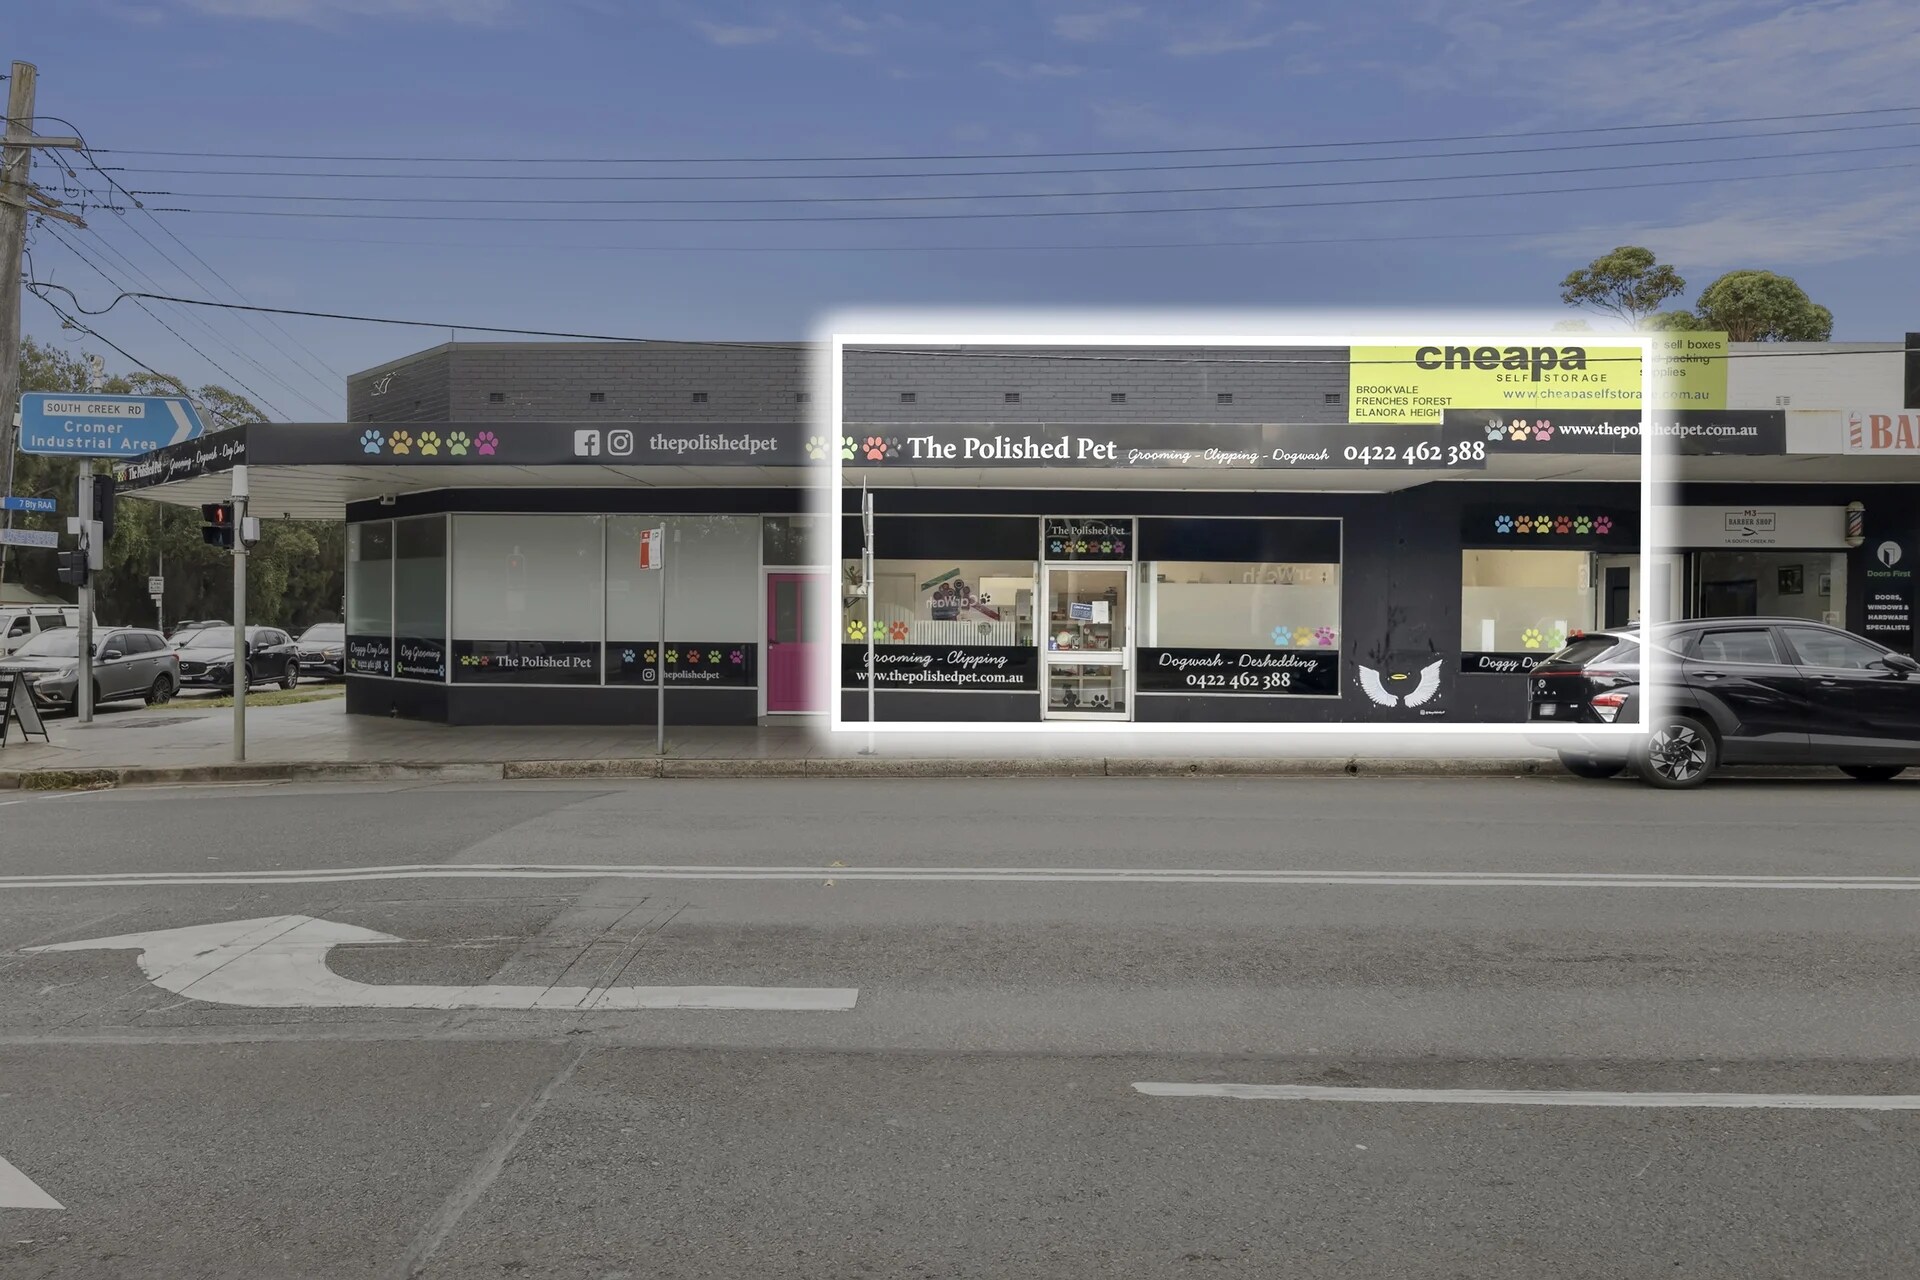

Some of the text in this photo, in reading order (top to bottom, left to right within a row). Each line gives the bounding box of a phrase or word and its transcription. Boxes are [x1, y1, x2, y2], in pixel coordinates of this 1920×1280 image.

[1664, 340, 1683, 350] sell
[1687, 339, 1721, 350] boxes
[1666, 353, 1711, 365] packing
[1496, 374, 1607, 383] SELF STORAGE
[1639, 367, 1687, 379] pplies
[1356, 385, 1419, 394] BROOKVALE
[1503, 387, 1710, 401] www.cheapaselfstorae.com.au
[1355, 396, 1453, 406] FRENCHES FOREST
[47, 402, 142, 416] SOUTH CREEK RD
[1355, 408, 1406, 417] ELANORA
[63, 420, 124, 434] Cromer
[1558, 421, 1759, 439] www.thepolhedpet.com.au
[31, 434, 157, 451] Industrial Area
[649, 433, 778, 455] thepolishedpet
[906, 435, 1118, 460] The Polished Pet
[1127, 448, 1192, 465] Grooming
[1203, 448, 1260, 465] Clipping
[1272, 448, 1330, 464] Dogwash
[1343, 445, 1397, 466] 0422
[1402, 441, 1442, 466] 462
[1447, 440, 1486, 466] 388
[19, 499, 24, 508] 7
[37, 500, 53, 510] RAA
[1744, 509, 1757, 517] M3
[1728, 518, 1773, 526] BARBER SHOP
[1051, 525, 1126, 536] The Polished Pet
[1866, 570, 1911, 578] Doors First
[495, 655, 592, 668] The Polished Pet
[946, 650, 1009, 669] Clipping
[1158, 652, 1224, 672] Dogwash
[1238, 653, 1319, 673] Deshedding
[1478, 656, 1543, 672] Doggy Da
[662, 669, 720, 681] hepolishedpet
[1186, 672, 1291, 690] 0422 462 388
